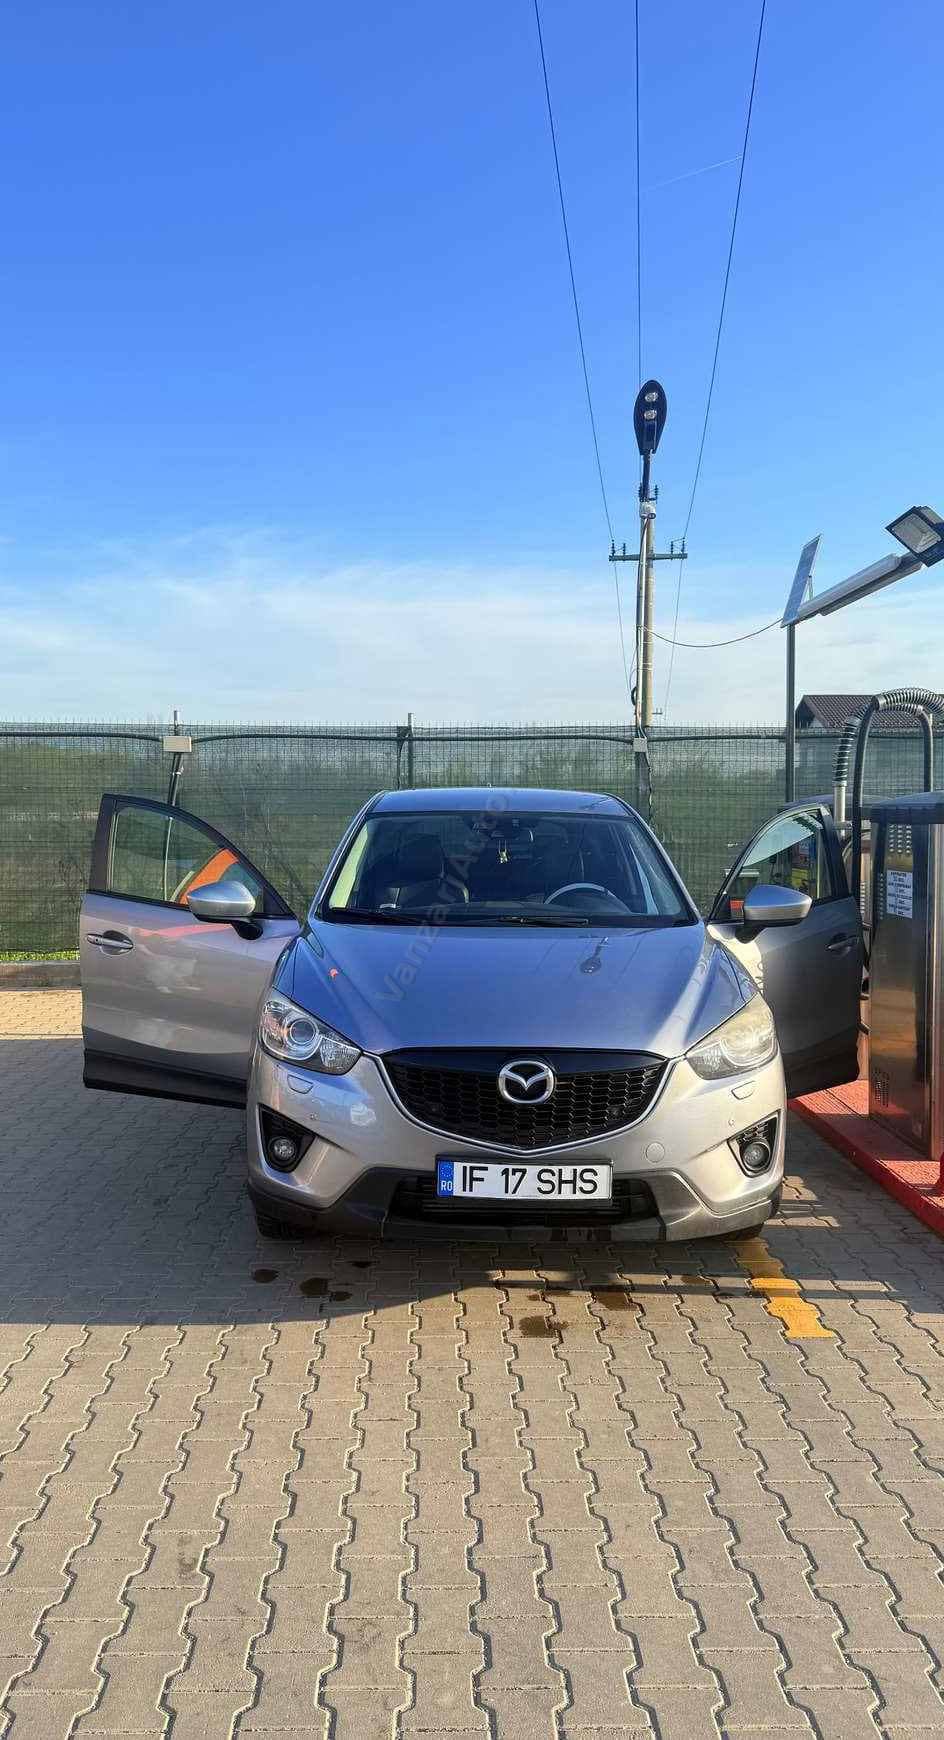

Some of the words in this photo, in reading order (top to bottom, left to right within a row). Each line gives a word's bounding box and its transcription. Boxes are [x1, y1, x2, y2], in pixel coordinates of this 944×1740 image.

[440, 1180, 454, 1192] RO
[462, 1165, 489, 1193] IF
[501, 1167, 528, 1195] 17
[536, 1168, 599, 1195] SHS
